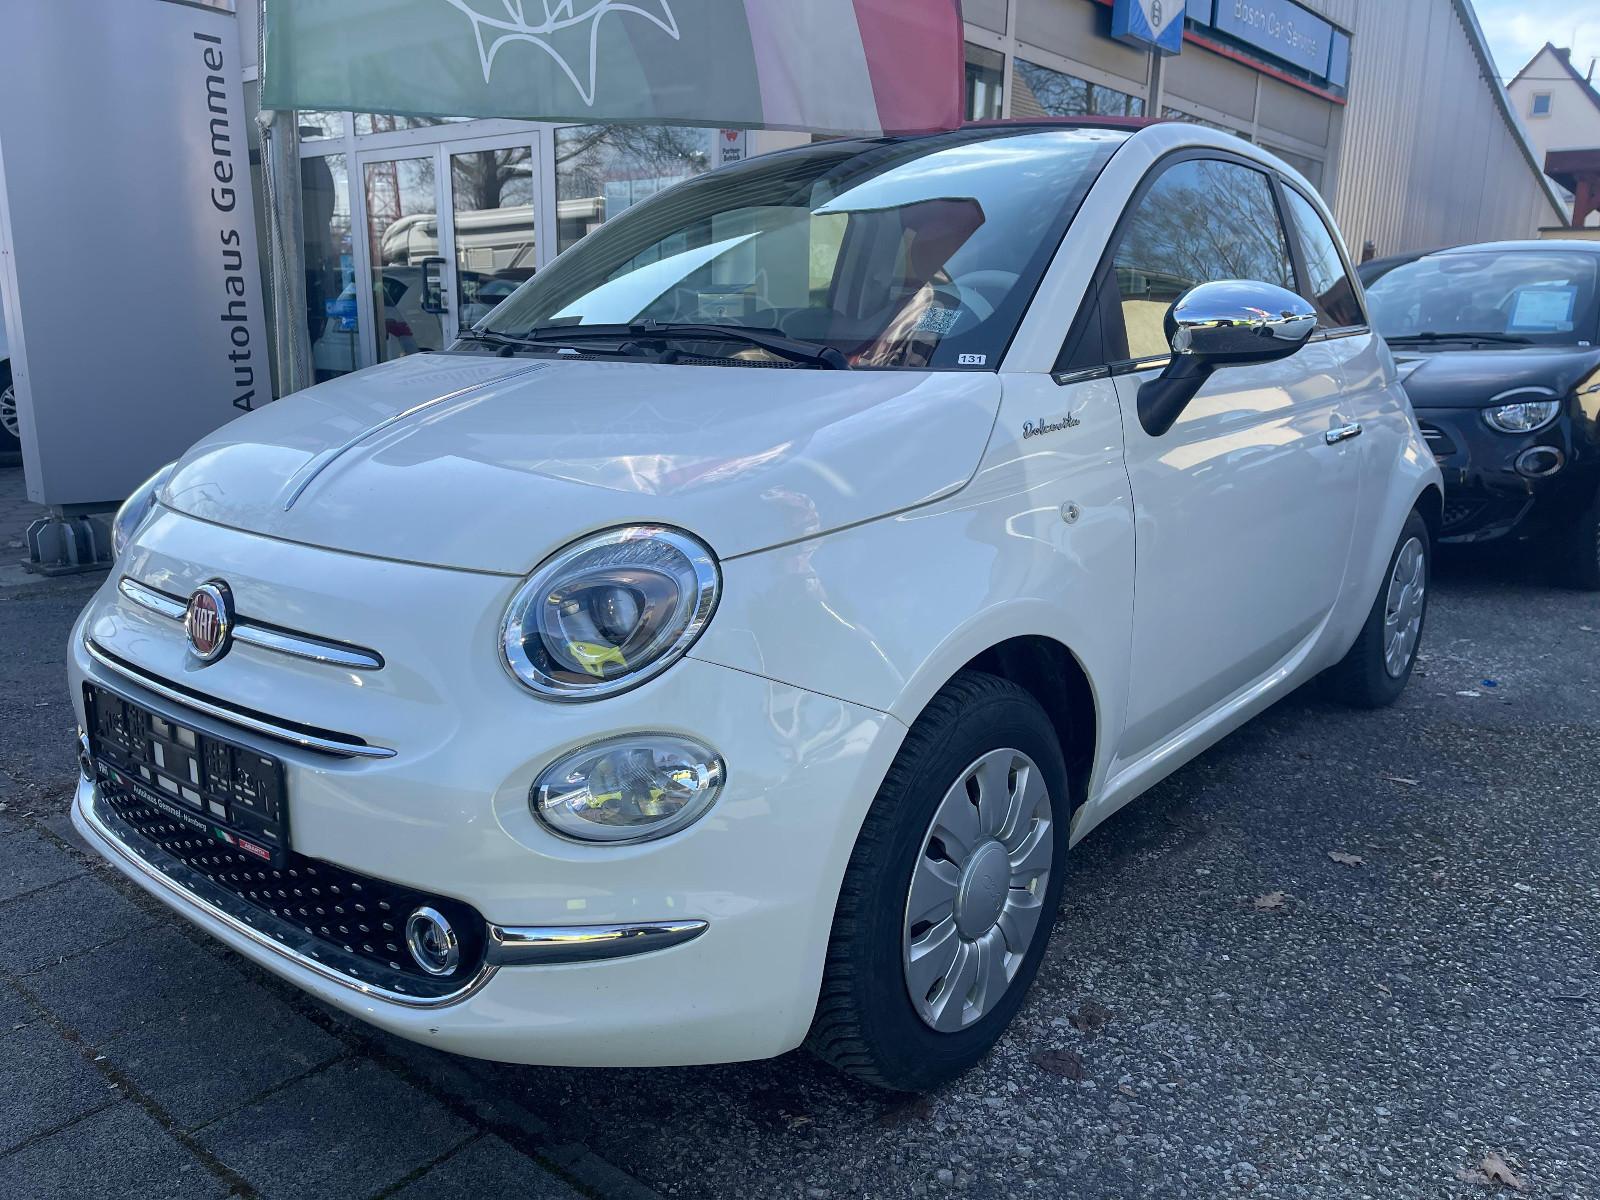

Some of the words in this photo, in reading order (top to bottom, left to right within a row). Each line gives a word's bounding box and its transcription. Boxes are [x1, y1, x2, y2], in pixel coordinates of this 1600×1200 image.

[1234, 0, 1266, 31] Bosch
[1268, 12, 1284, 38] Car
[193, 32, 236, 212] Gemmel
[220, 229, 255, 413] Autohaus
[960, 355, 983, 364] 131
[1023, 411, 1080, 439] Dolcevita
[192, 606, 215, 641] FIAT
[133, 784, 158, 805] Autohaus
[157, 798, 181, 817] Gemmel
